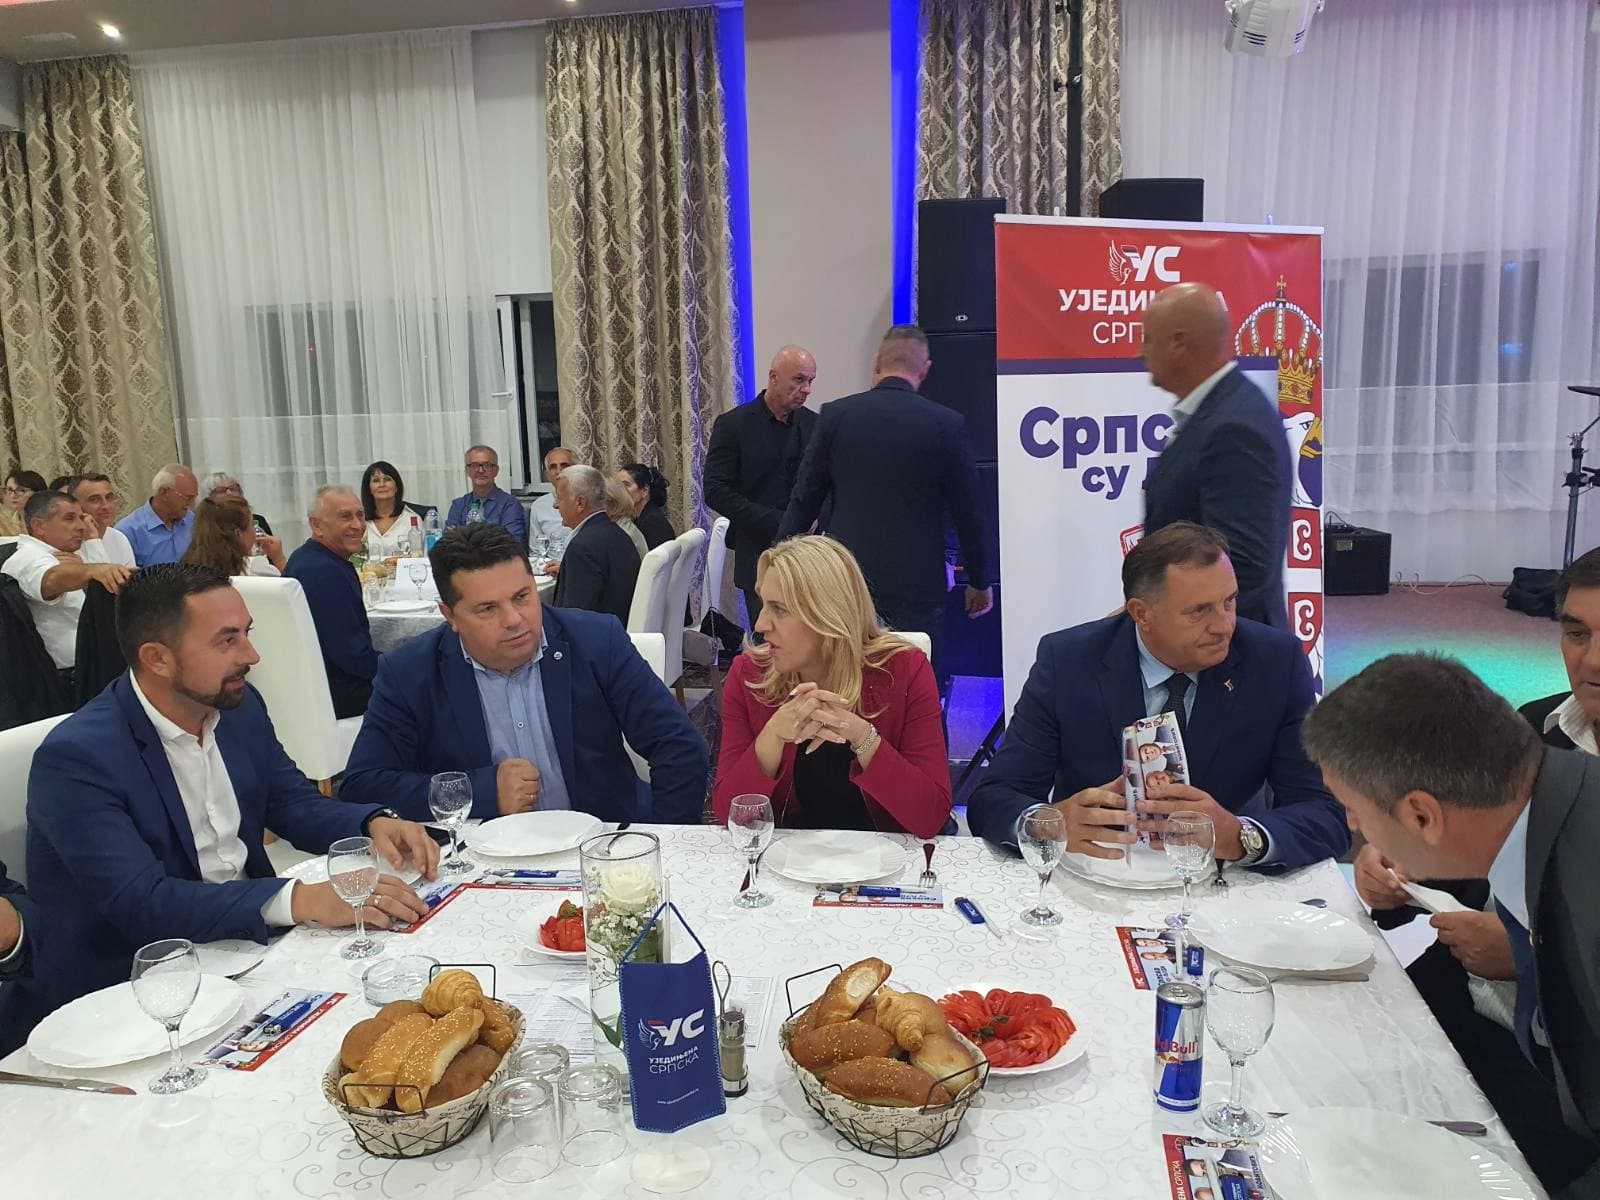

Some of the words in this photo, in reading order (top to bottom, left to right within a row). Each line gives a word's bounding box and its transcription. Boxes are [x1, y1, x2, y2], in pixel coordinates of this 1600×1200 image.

[1125, 245, 1181, 282] УС
[1092, 321, 1145, 344] СРП
[1019, 406, 1172, 468] Српс
[1081, 465, 1131, 500] су
[652, 1008, 705, 1046] УС
[648, 1052, 700, 1075] СРПСКА
[1170, 1041, 1196, 1054] Bull
